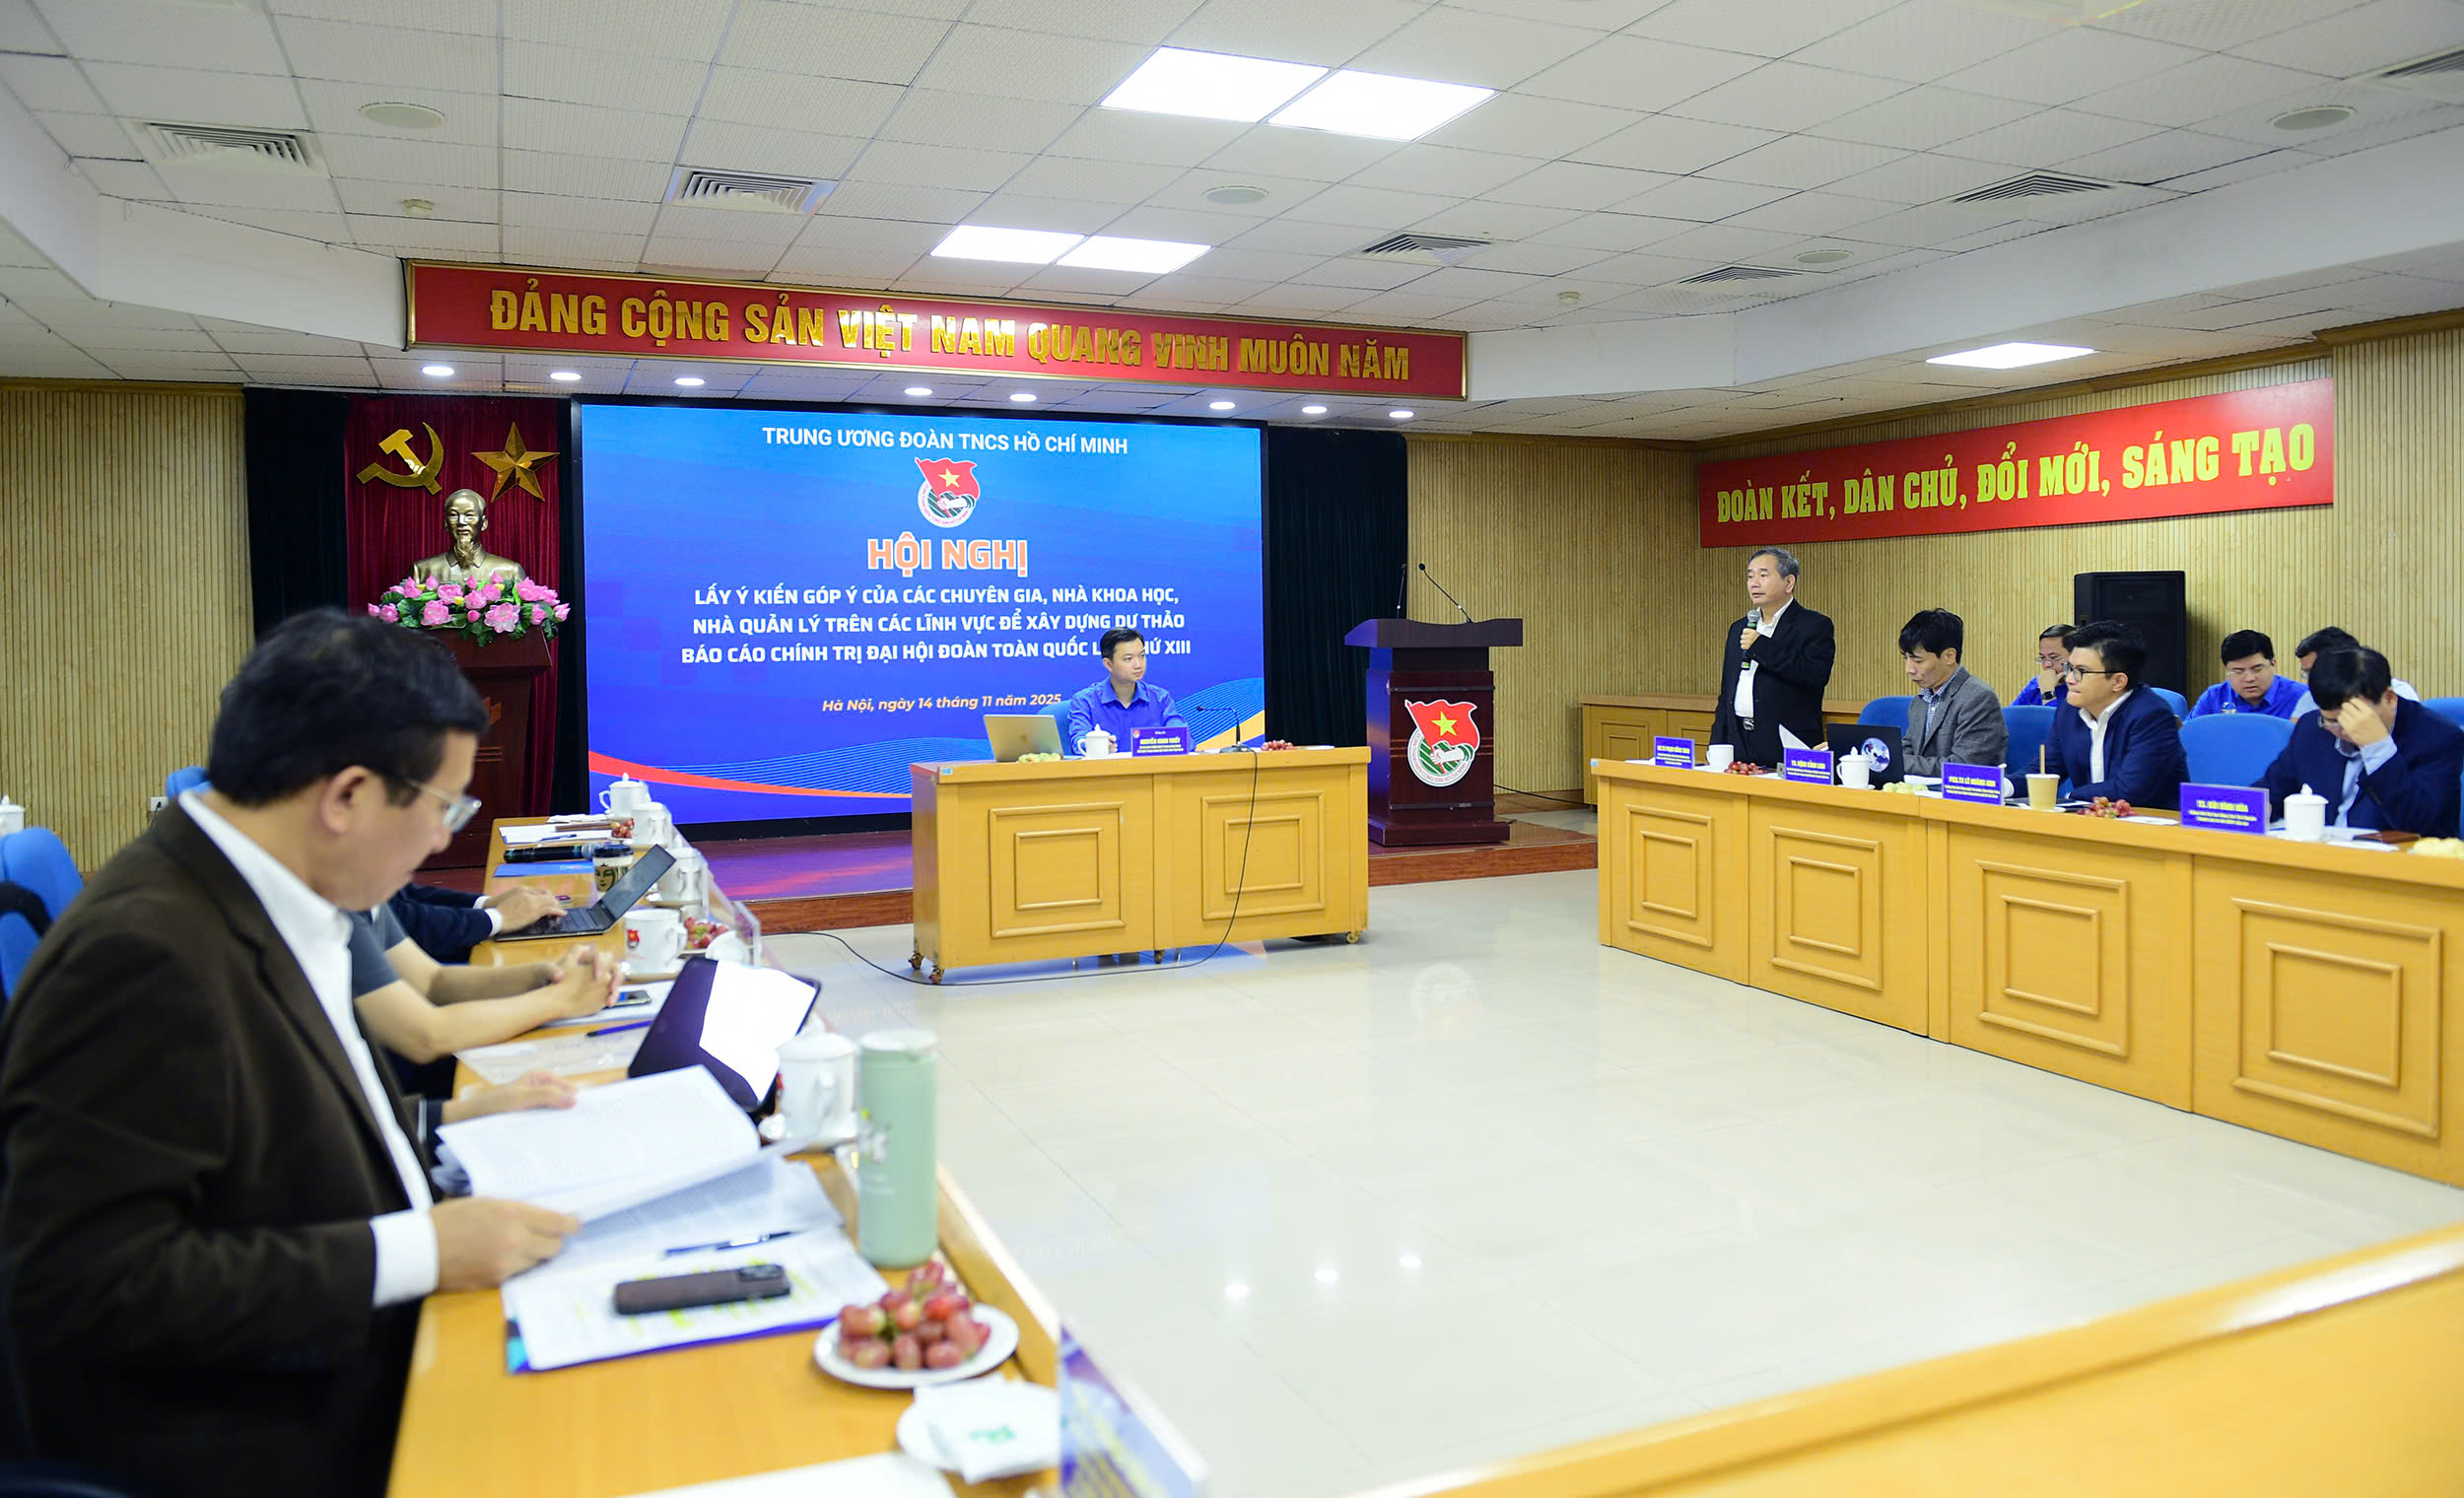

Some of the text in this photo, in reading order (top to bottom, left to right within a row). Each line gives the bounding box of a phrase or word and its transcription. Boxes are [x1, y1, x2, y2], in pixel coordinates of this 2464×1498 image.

[491, 279, 1408, 380] ĐẢNG CỘNG SẢN VIỆT NAM QUANG VINH MUÔN NĂM
[763, 428, 1127, 453] TRUNG ƯƠNG ĐOÀN TNCS HỒ CHÍ MINH
[1718, 423, 2316, 522] ĐOÀN KẾT, DÂN CHỦ, ĐỔI MỚI, SÁNG TẠO
[866, 531, 1029, 578] HỘI NGHỊ
[695, 582, 1178, 605] LẤY Ý KIẾN GÓP Ý CỦA CÁC CHUYÊN GIA, NHÀ KHOA HỌC,
[694, 615, 734, 634] NHÀ
[740, 614, 792, 635] QUẢN
[799, 614, 820, 632] LÝ
[825, 614, 872, 632] TRÊN
[878, 614, 911, 631] CÁC
[917, 614, 956, 631] LĨNH
[961, 615, 994, 634] VỰC
[999, 609, 1021, 630] ĐỂ
[1026, 612, 1061, 630] XÂY
[1065, 614, 1110, 632] DỰNG
[1141, 610, 1184, 628] THẢO
[682, 645, 721, 662] BÁO
[728, 644, 765, 662] CÁO
[771, 643, 827, 661] CHÍNH
[833, 647, 861, 663] TRỊ
[866, 646, 897, 663] ĐẠI
[903, 642, 933, 662] HỘI
[938, 641, 987, 658] ĐOÀN
[992, 640, 1038, 657] TOÀN
[1044, 636, 1088, 658] QUỐC
[1165, 641, 1191, 654] XIII
[823, 693, 1061, 713] Hà Nội, ngày 14 tháng 11 năm 2025
